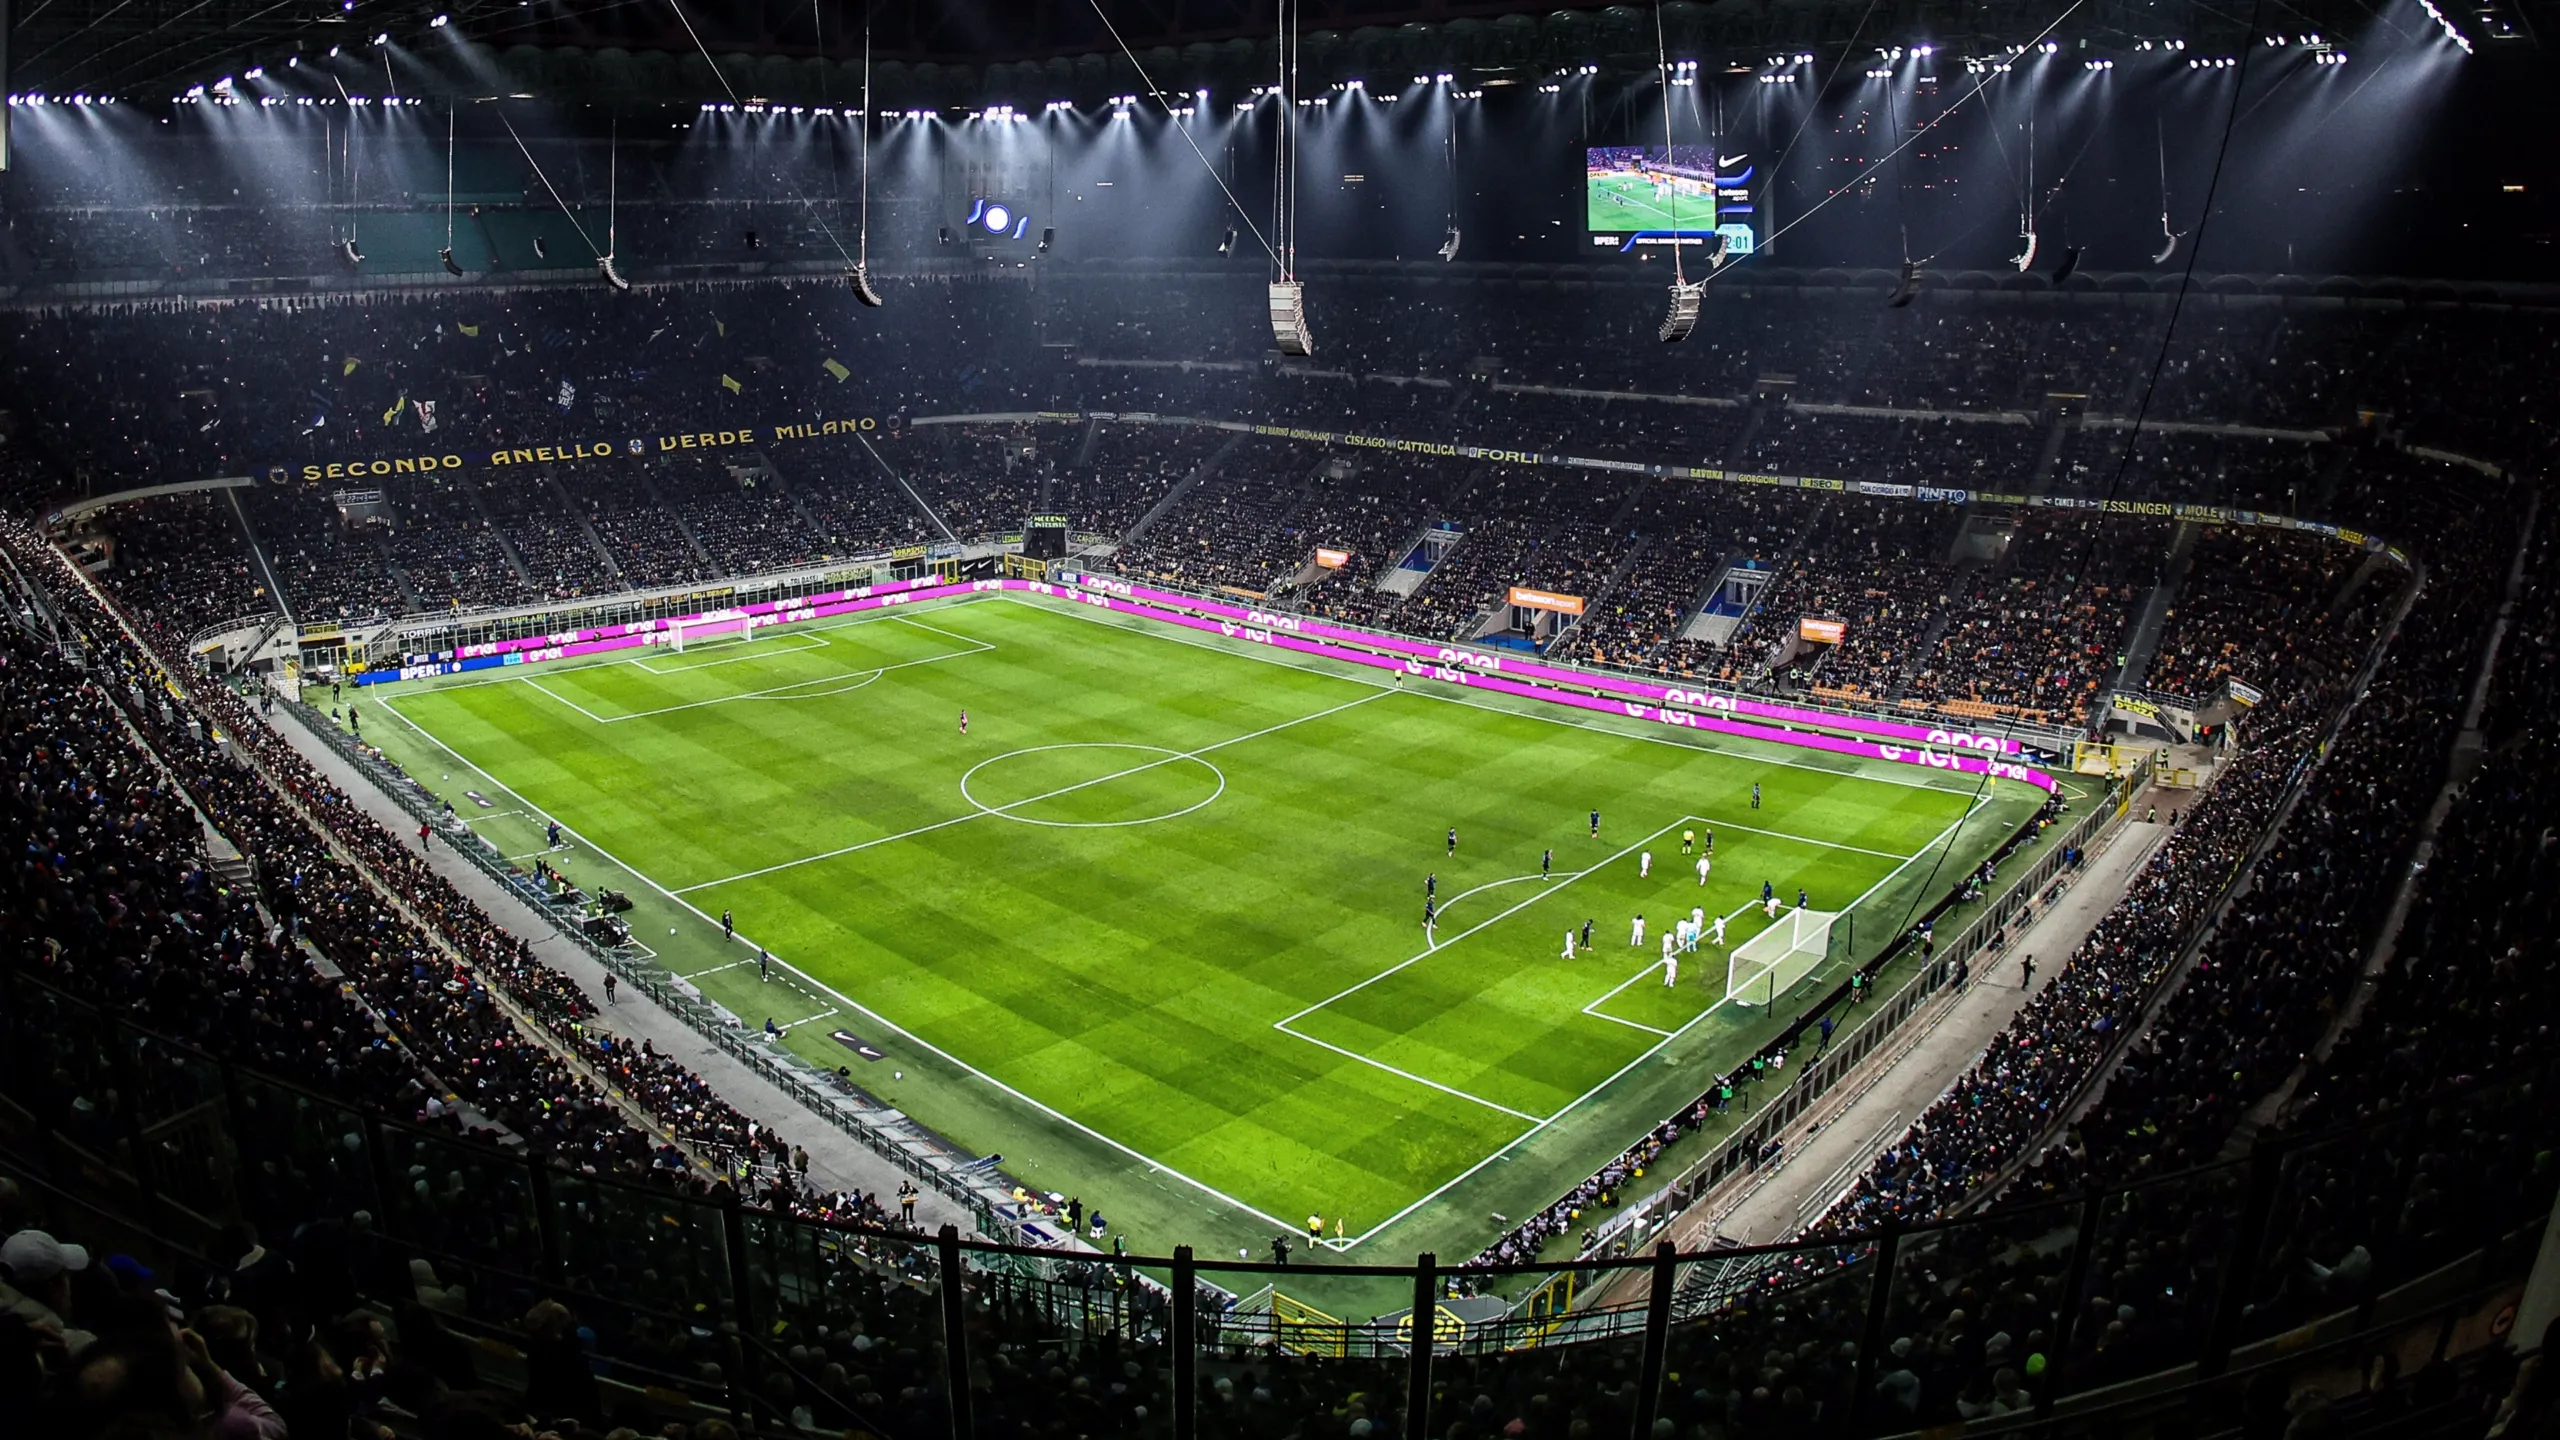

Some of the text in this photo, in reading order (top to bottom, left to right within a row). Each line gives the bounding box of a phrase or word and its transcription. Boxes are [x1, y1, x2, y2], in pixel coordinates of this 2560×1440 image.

[659, 417, 877, 451] VERDE MILANO
[1344, 434, 1386, 449] CISLAGO
[1396, 439, 1456, 456] CATTOLICA
[303, 442, 612, 482] SECONDO ANELLO
[1689, 467, 1723, 480] SAVONA
[1738, 474, 1779, 485] GIORGIONE
[1809, 479, 1832, 489] ISEO
[2102, 499, 2172, 516] ESSLINGEN
[2185, 504, 2218, 518] MOLE
[910, 575, 936, 589] enel
[1061, 572, 1077, 583] INTER
[844, 586, 871, 600] enel
[972, 579, 1003, 592] enel
[1028, 581, 1053, 595] enel
[1086, 577, 1132, 596] enel
[774, 597, 803, 611] enel
[881, 593, 910, 606] enel
[750, 613, 778, 628] enel
[786, 607, 815, 622] enel
[1247, 610, 1300, 632] enel
[401, 626, 450, 639] TORRITA
[625, 620, 656, 634] enel
[547, 631, 578, 646] enel
[463, 642, 497, 658] enel
[528, 647, 563, 663] enel
[1437, 648, 1500, 670] enel
[400, 663, 443, 681] BPER:
[1664, 688, 1738, 712] enel
[1926, 729, 2010, 754] enel
[1986, 756, 2029, 782] enel
